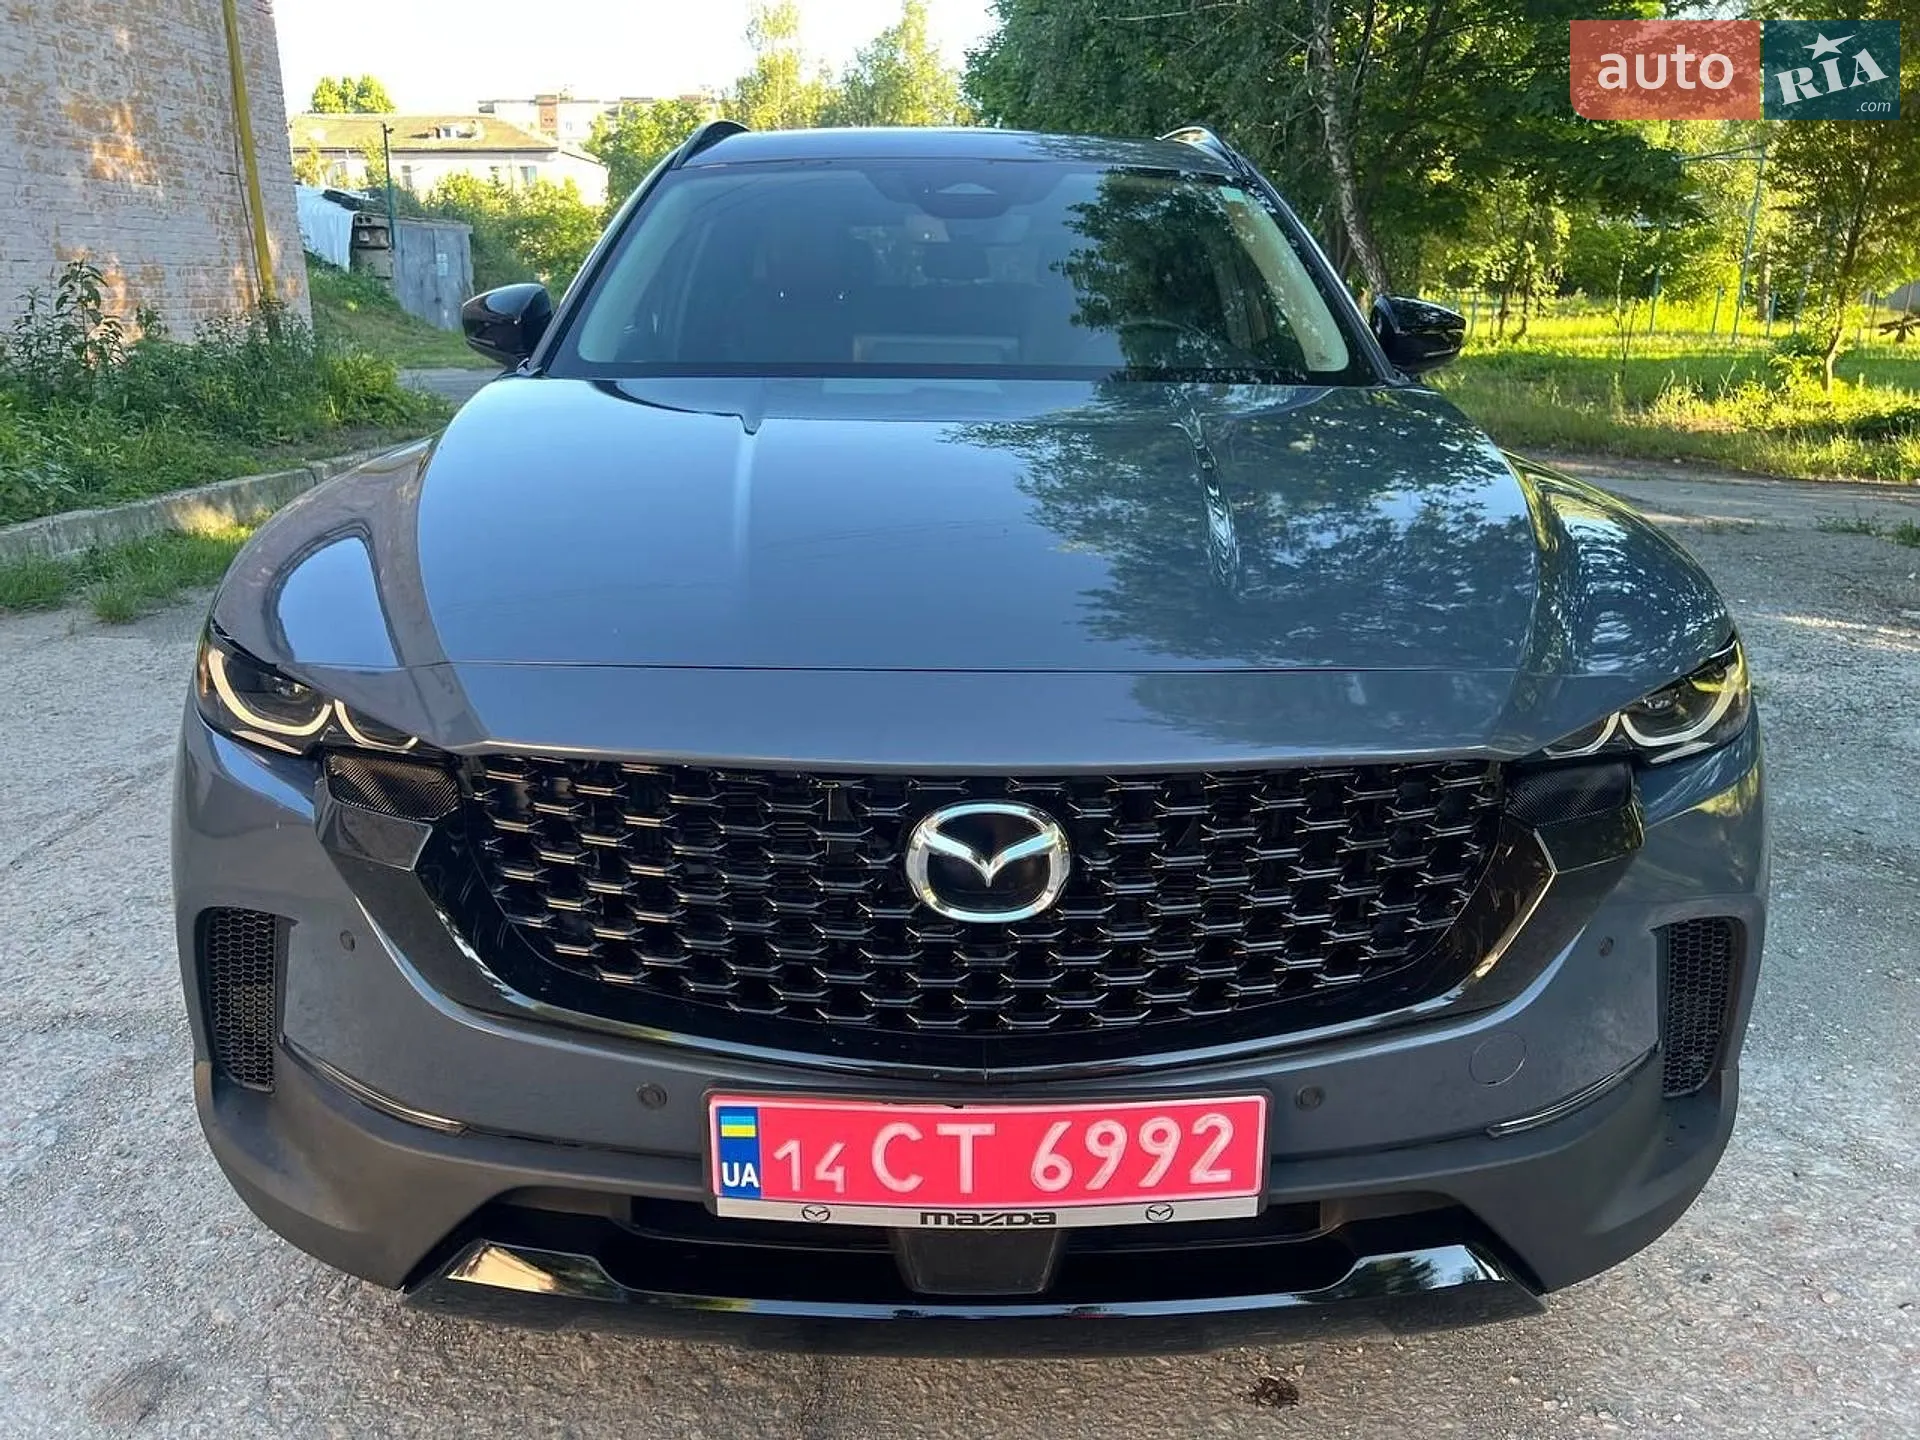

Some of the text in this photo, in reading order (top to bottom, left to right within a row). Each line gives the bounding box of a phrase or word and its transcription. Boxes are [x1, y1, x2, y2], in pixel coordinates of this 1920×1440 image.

[721, 1162, 760, 1189] UA
[773, 1113, 1235, 1195] 14 CT 6992
